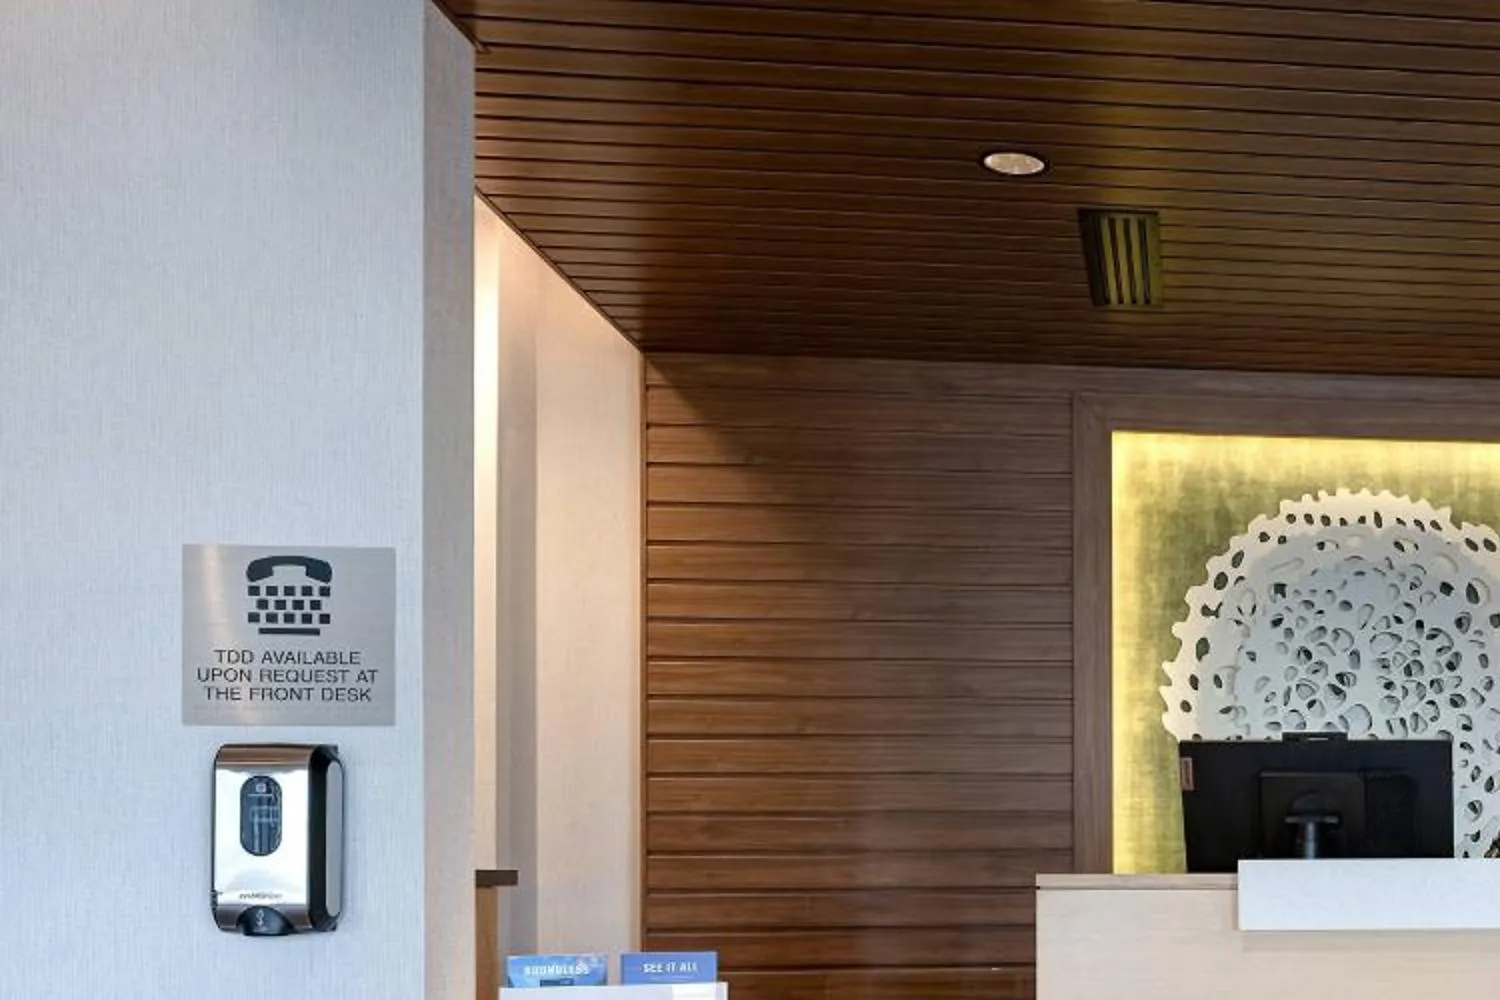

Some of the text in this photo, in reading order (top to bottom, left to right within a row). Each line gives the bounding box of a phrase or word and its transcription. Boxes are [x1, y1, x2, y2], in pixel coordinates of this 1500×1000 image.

[214, 649, 361, 665] TDD AVAILABLE
[197, 667, 378, 684] UPON REQUEST AT
[204, 686, 372, 702] THE FRONT DESK
